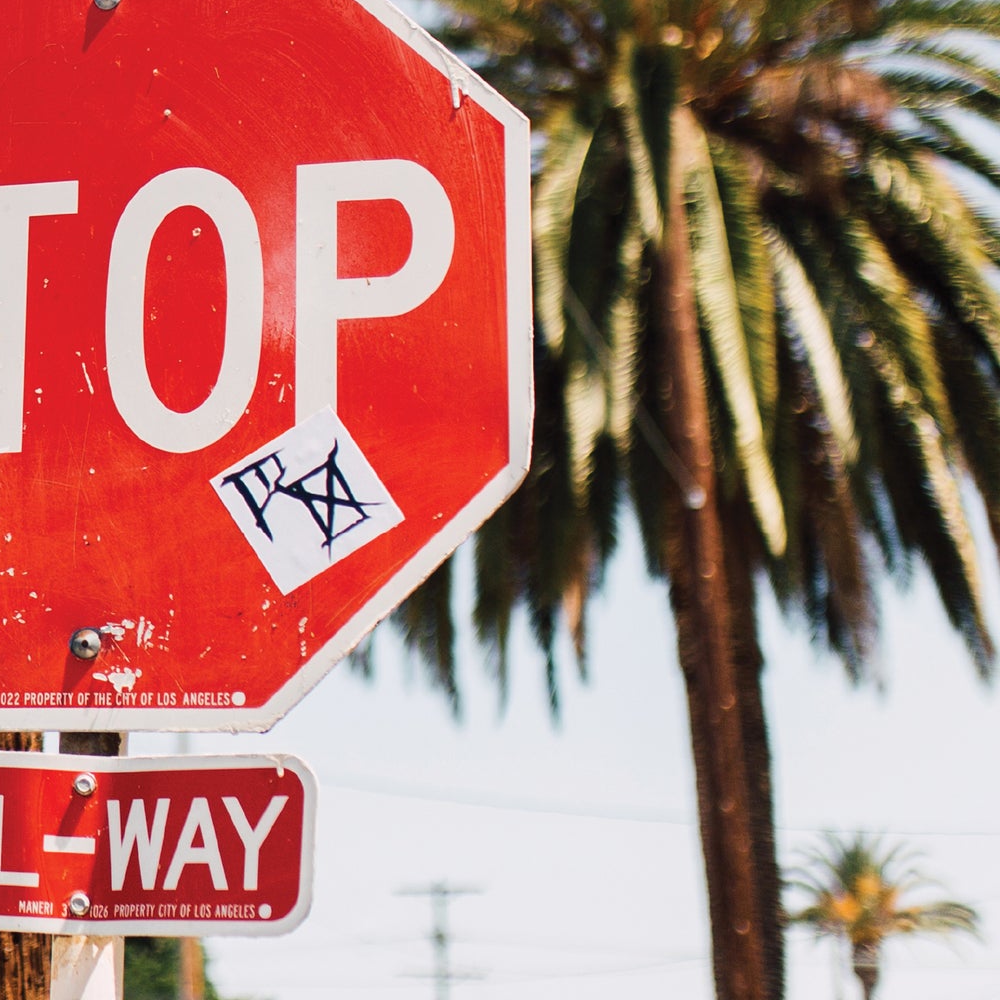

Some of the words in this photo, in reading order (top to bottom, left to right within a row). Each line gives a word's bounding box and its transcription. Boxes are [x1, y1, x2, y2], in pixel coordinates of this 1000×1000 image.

[24, 692, 74, 706] PROPERTY
[77, 692, 90, 706] OF
[94, 692, 112, 706] THE
[115, 692, 137, 706] CITY
[140, 692, 153, 706] OF
[157, 692, 177, 706] LOS
[183, 692, 230, 706] ANGELES
[19, 900, 53, 915] MANERI
[114, 904, 155, 918] PROPERTY
[158, 904, 177, 918] CITY
[180, 904, 191, 918] OF
[194, 904, 211, 918] LOS
[215, 904, 255, 918] ANGELES
